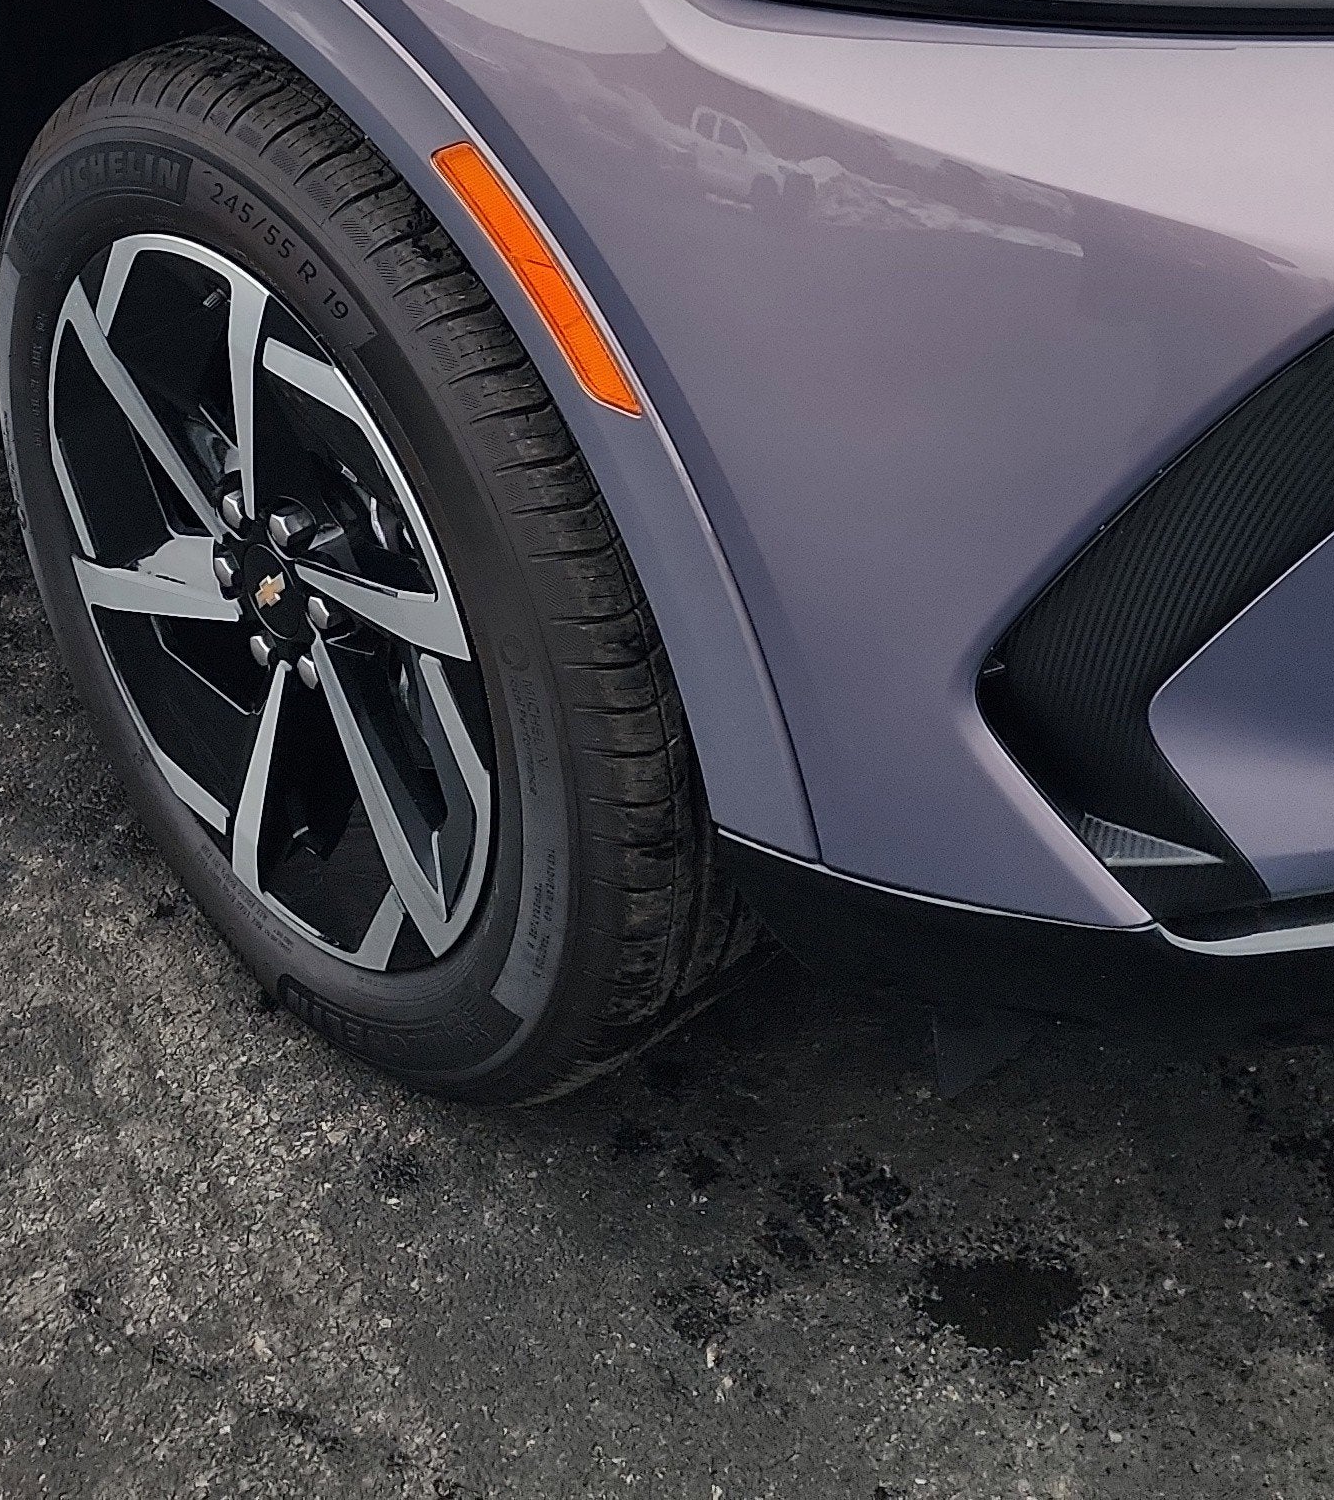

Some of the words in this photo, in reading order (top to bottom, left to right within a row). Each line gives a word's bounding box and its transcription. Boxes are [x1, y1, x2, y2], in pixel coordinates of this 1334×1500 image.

[41, 150, 181, 207] MICHELIN
[211, 180, 296, 260] 245/55
[296, 259, 318, 285] R
[322, 287, 349, 320] 19
[524, 679, 550, 769] MICHELIN
